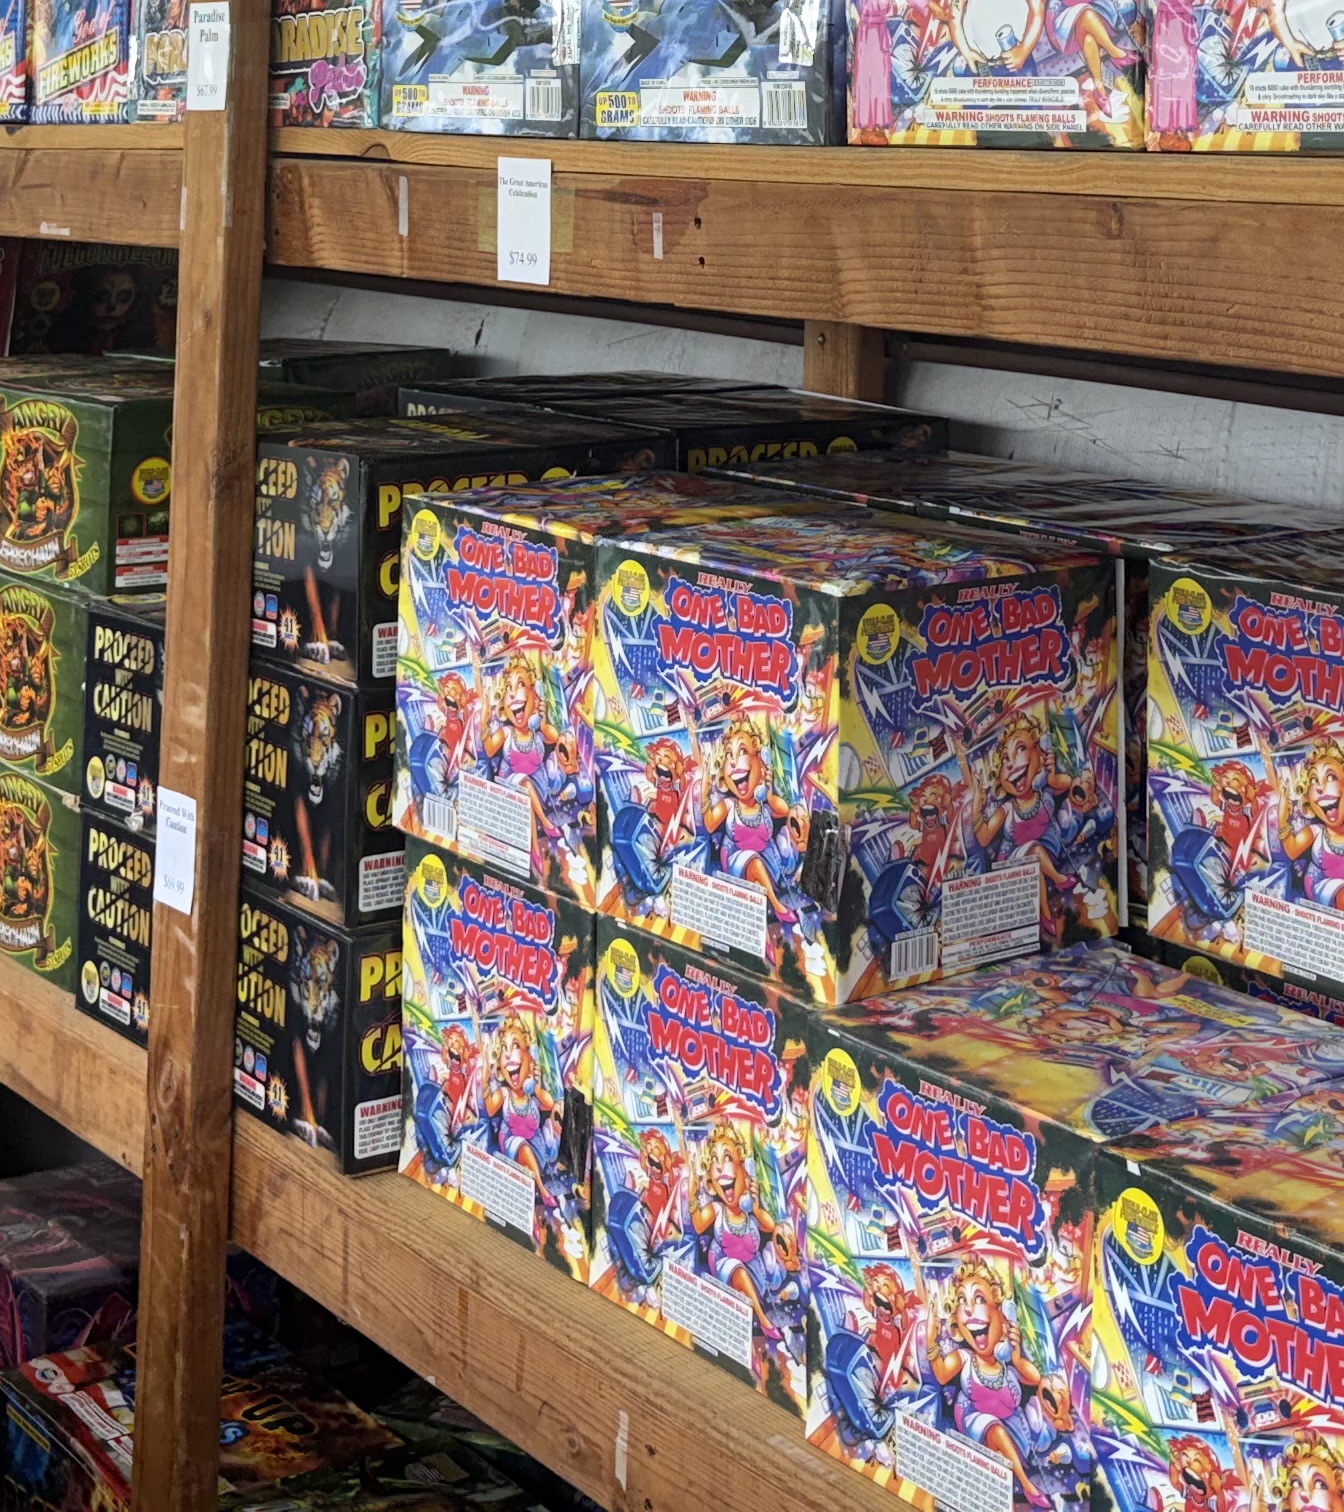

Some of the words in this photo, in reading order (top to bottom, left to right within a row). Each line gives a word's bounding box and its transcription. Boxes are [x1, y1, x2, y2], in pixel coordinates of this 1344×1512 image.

[193, 9, 226, 24] Paradise
[199, 28, 219, 44] Palm
[1250, 110, 1310, 123] WARNING
[13, 400, 70, 431] ANGRY
[698, 571, 754, 595] REALLY
[1270, 590, 1339, 617] REALLY
[671, 590, 727, 628] ONE
[736, 598, 788, 639] BAD
[1236, 604, 1307, 652] ONE
[93, 624, 156, 676] PROCEED
[659, 623, 792, 692] MOTHER
[93, 682, 153, 734] CAUTION
[1194, 1239, 1282, 1312] ONE
[1236, 1227, 1322, 1277] REALLY
